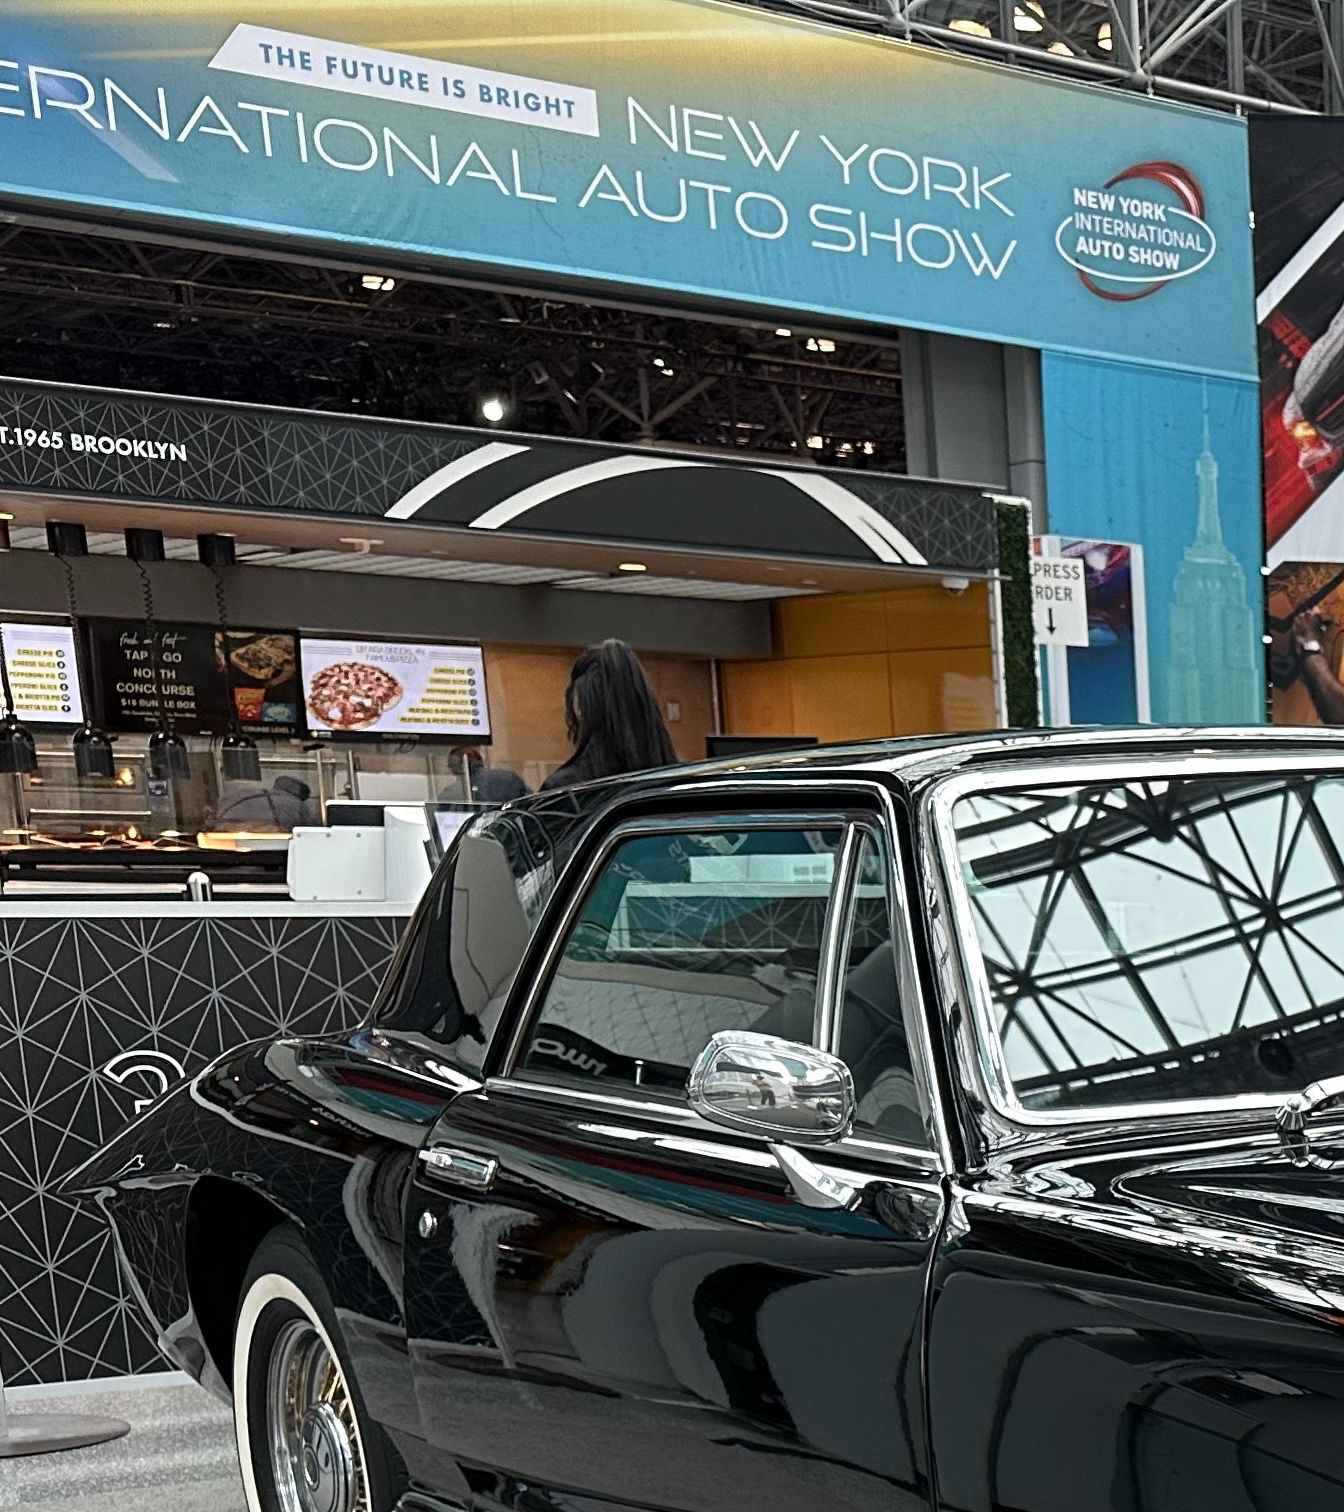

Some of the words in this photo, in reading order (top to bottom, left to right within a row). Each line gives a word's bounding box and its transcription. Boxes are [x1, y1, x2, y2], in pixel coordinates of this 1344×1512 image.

[258, 42, 312, 72] THE
[325, 55, 430, 93] FUTURE
[442, 76, 467, 99] IS
[479, 83, 576, 120] BRIGHT
[627, 96, 800, 172] NEW
[819, 134, 1015, 217] YORK
[1073, 187, 1116, 212] NEW
[1118, 196, 1167, 222] YORK
[579, 164, 788, 240] AUTO
[809, 203, 1017, 280] SHOW
[1074, 212, 1206, 253] INTERNATIONAL
[1076, 236, 1125, 260] AUTO
[1128, 245, 1180, 271] SHOW
[70, 432, 187, 462] BROOKLYN
[1033, 563, 1081, 580] PRESS
[1035, 584, 1073, 602] RDER
[124, 649, 149, 661] TAP
[162, 652, 182, 663] GO
[133, 667, 176, 679] NOTH
[139, 699, 175, 708] BUNLE
